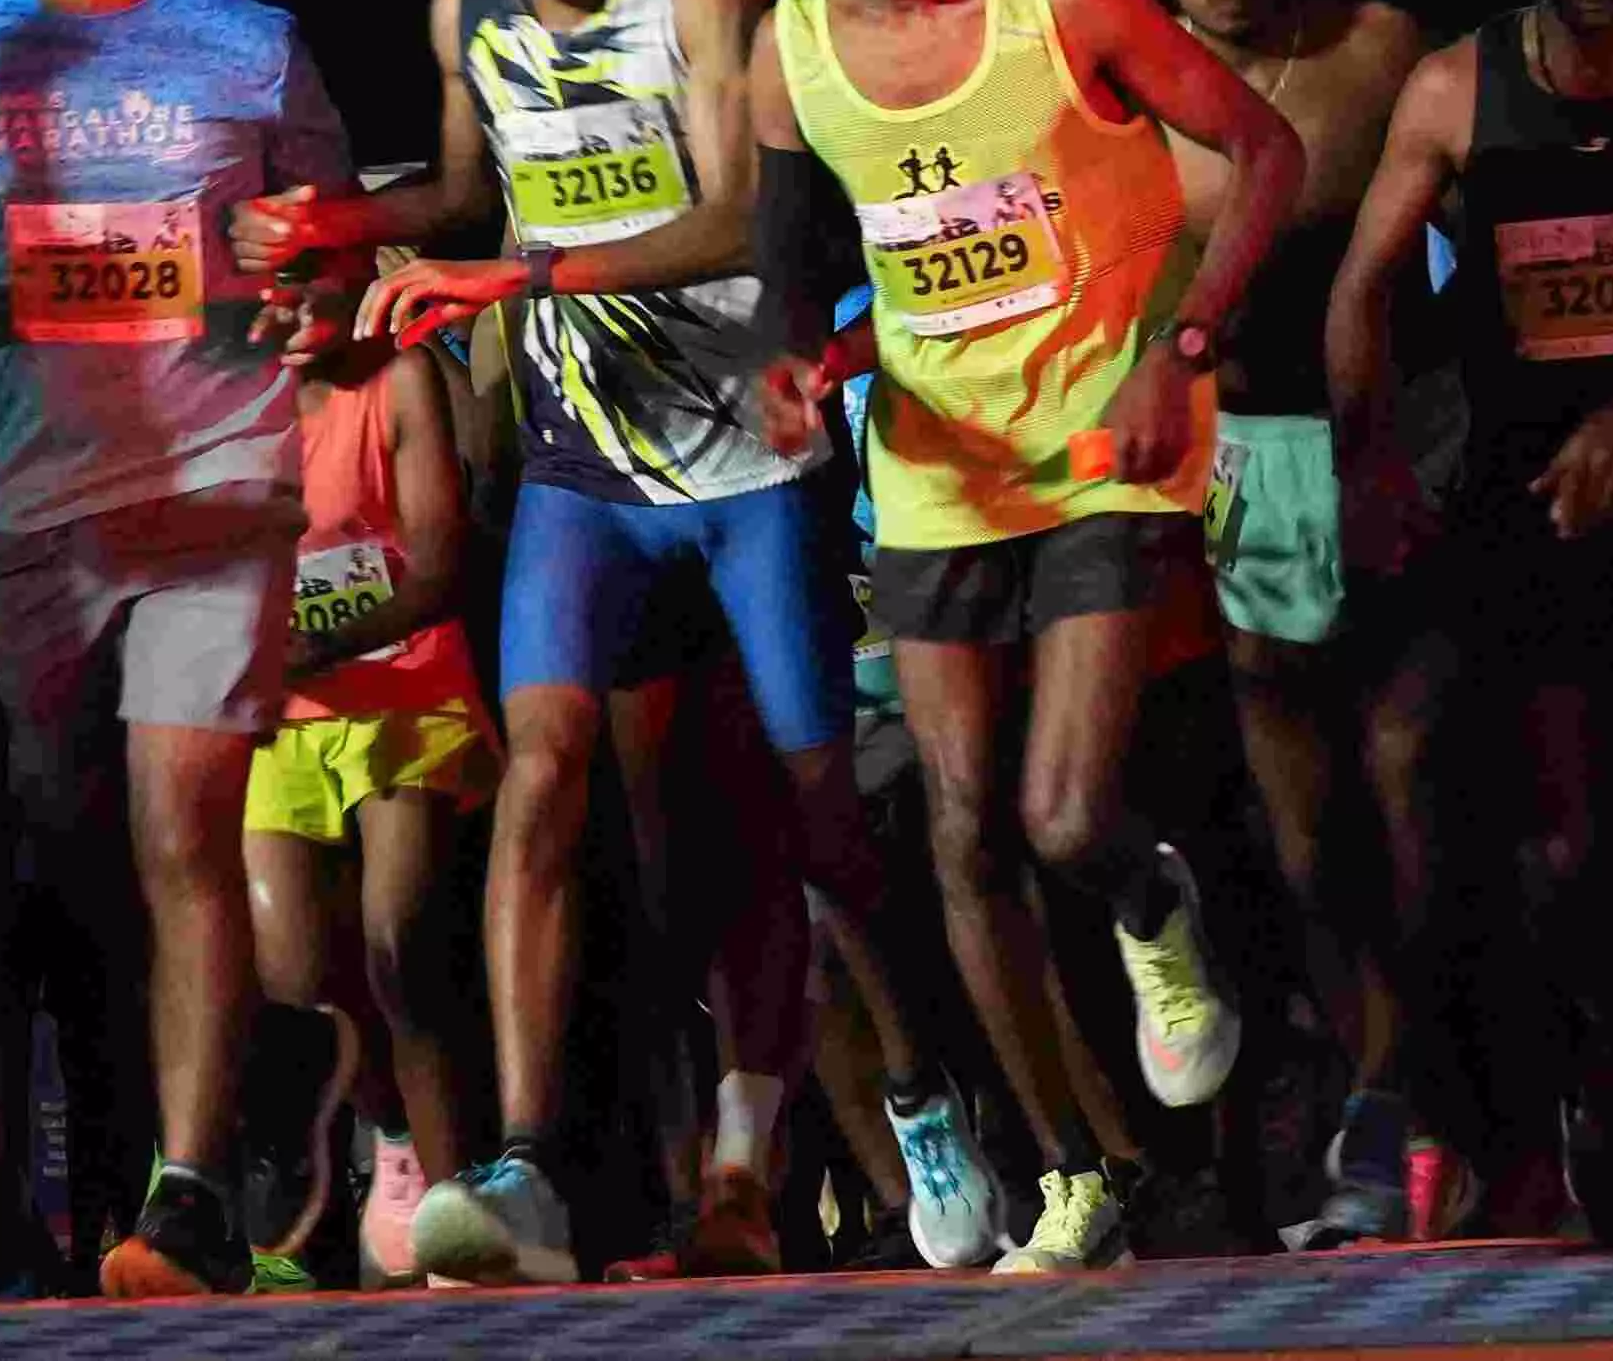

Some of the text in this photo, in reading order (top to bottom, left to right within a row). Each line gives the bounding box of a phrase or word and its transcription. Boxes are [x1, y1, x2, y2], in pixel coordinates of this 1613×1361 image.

[546, 155, 658, 207] 32136
[50, 259, 182, 303] 32028
[903, 233, 1029, 296] 32129
